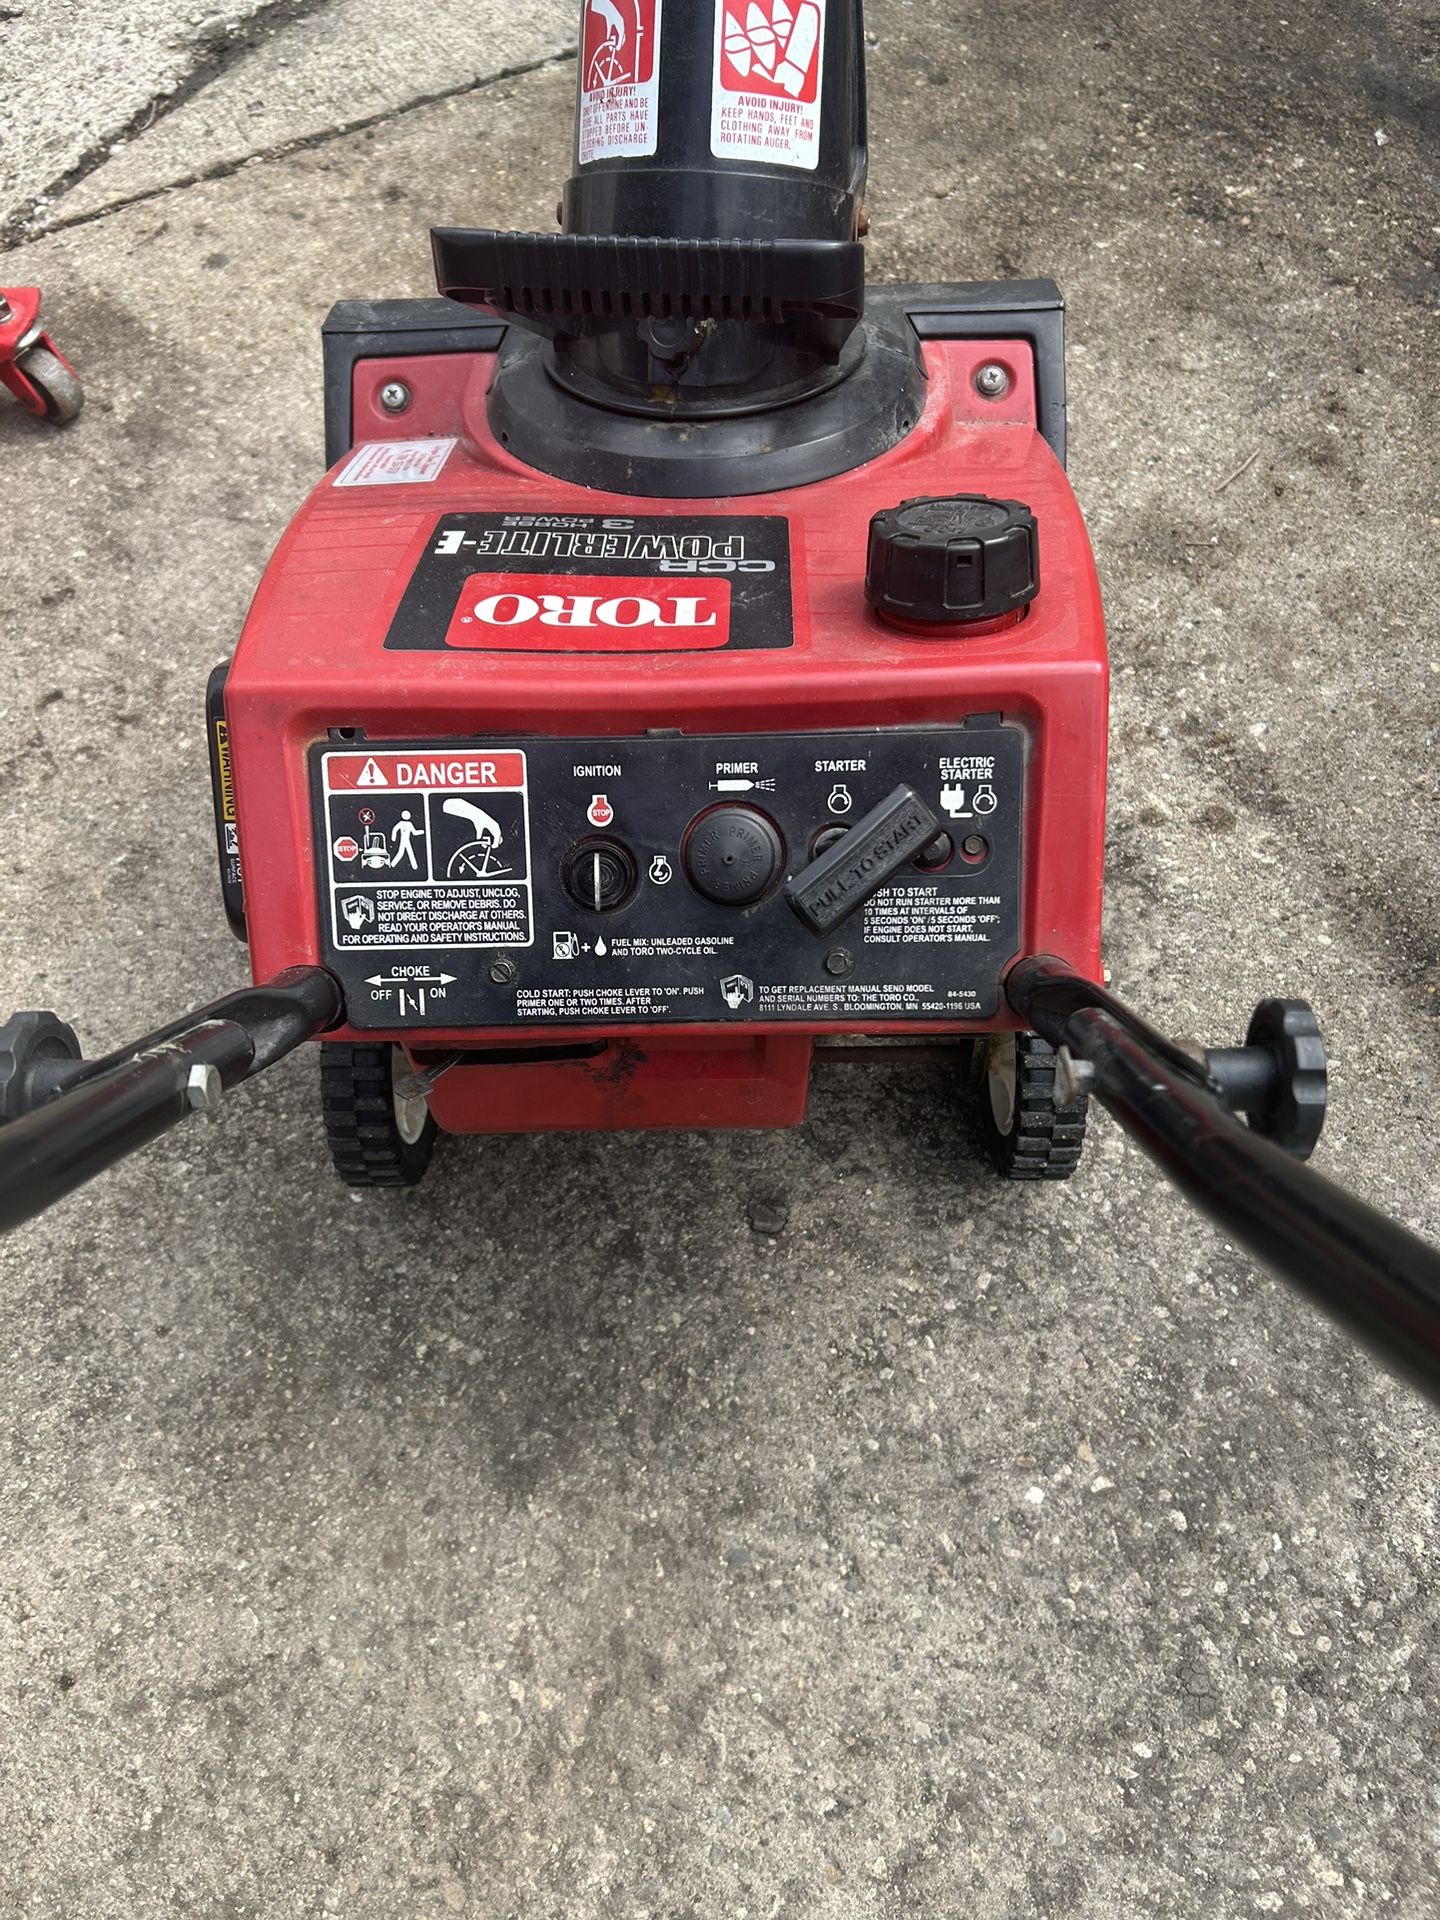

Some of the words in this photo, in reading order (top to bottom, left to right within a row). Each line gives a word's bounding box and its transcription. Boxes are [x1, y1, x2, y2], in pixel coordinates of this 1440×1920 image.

[589, 89, 605, 103] AVOID
[607, 86, 636, 99] INJURY!
[625, 98, 638, 109] AND
[640, 97, 649, 108] BE
[738, 95, 767, 109] AVOID
[770, 99, 804, 115] INJURY!
[594, 115, 603, 125] ALL
[606, 111, 627, 123] PARTS
[630, 110, 649, 121] HAVE
[721, 106, 744, 119] KEEP
[748, 109, 777, 124] HANDS,
[781, 114, 798, 126] FEET
[801, 118, 814, 130] AND
[605, 122, 630, 135] BEFORE
[720, 120, 763, 133] CLOTHING
[768, 125, 791, 137] AWAY
[795, 129, 813, 142] FROM
[608, 133, 648, 146] DISCHARGE
[720, 132, 762, 146] ROTATING
[764, 137, 791, 150] AUGER.
[504, 515, 594, 523] POWER
[602, 519, 635, 530] 3
[435, 530, 744, 560] POWERLITE-E
[659, 559, 777, 573] CCR
[716, 763, 759, 774] PRIMER
[815, 760, 866, 772] STARTER
[939, 757, 995, 769] ELECTRIC
[396, 762, 498, 786] DANGER
[573, 765, 622, 777] IGNITION
[940, 769, 993, 780] STARTER
[592, 809, 611, 817] STOP
[339, 845, 356, 853] STOP
[729, 826, 763, 862] PRIMER
[808, 876, 854, 918] PULL
[849, 856, 875, 879] TO
[873, 813, 924, 861] START
[376, 890, 399, 900] STOP
[401, 889, 432, 899] ENGINE
[434, 889, 446, 899] TO
[447, 888, 481, 899] ADJUST,
[482, 888, 521, 899] UNCLOG,
[892, 888, 905, 897] TO
[907, 887, 938, 897] START
[377, 901, 416, 911] SERVICE,
[417, 900, 430, 910] OR
[431, 900, 468, 910] REMOVE
[469, 899, 502, 909] DEBRIS.
[503, 899, 516, 909] DO
[896, 898, 913, 906] RUN
[915, 898, 951, 906] STARTER
[953, 897, 976, 905] MORE
[978, 896, 1001, 905] THAN
[378, 912, 396, 922] NOT
[397, 911, 428, 921] DIRECT
[429, 910, 478, 921] DISCHARGE
[479, 910, 490, 920] AT
[491, 910, 527, 920] OTHERS.
[864, 908, 873, 916] 10
[874, 908, 899, 916] TIMES
[900, 907, 910, 915] AT
[912, 907, 955, 915] INTERVALS
[957, 907, 968, 915] OF
[864, 917, 868, 925] 5
[870, 917, 909, 925] SECONDS
[937, 916, 976, 924] SECONDS
[379, 923, 403, 933] READ
[403, 922, 428, 933] YOUR
[429, 921, 482, 932] OPERATOR'S
[484, 921, 520, 931] MANUAL
[873, 926, 902, 934] ENGINE
[904, 926, 926, 934] DOES
[928, 925, 945, 933] NOT
[343, 935, 361, 945] FOR
[362, 934, 410, 945] OPERATING
[411, 933, 429, 944] AND
[430, 932, 463, 943] SAFETY
[464, 932, 527, 942] INSTRUCTIONS.
[612, 938, 630, 947] FUEL
[632, 938, 650, 947] MIX:
[651, 937, 694, 946] UNLEADED
[695, 937, 735, 946] GASOLINE
[864, 935, 901, 943] CONSULT
[902, 934, 953, 943] OPERATOR'S
[954, 934, 991, 942] MANUAL.
[612, 948, 629, 957] AND
[630, 947, 655, 956] TORO
[656, 946, 702, 956] TWO-CYCLE
[703, 946, 719, 955] OIL.
[391, 966, 430, 978] CHOKE
[371, 990, 392, 1001] OFF
[430, 988, 447, 999] ON
[517, 990, 541, 998] COLD
[542, 989, 572, 998] START:
[573, 989, 595, 998] PUSH
[596, 988, 623, 997] CHOKE
[625, 988, 650, 997] LEVER
[652, 988, 663, 996] TO
[683, 987, 705, 995] PUSH
[759, 986, 770, 994] TO
[771, 986, 788, 994] GET
[848, 985, 882, 993] MANUAL
[883, 985, 905, 993] SEND
[906, 985, 935, 993] MODEL
[517, 999, 547, 1007] PRIMER
[548, 998, 565, 1007] ONE
[567, 998, 579, 1007] OR
[579, 998, 598, 1006] TWO
[626, 997, 652, 1006] AFTER
[759, 995, 776, 1003] AND
[777, 995, 806, 1003] SERIAL
[847, 994, 860, 1002] TO:
[862, 994, 878, 1002] THE
[879, 994, 902, 1002] TORO
[517, 1008, 558, 1017] STARTING,
[559, 1007, 580, 1016] PUSH
[582, 1007, 610, 1015] CHOKE
[611, 1006, 637, 1015] LEVER
[638, 1006, 649, 1014] TO
[759, 1004, 775, 1012] 8111
[777, 1004, 812, 1012] LYNDALE
[844, 1003, 904, 1012] BLOOMINGTON,
[906, 1003, 918, 1011] MN
[965, 1002, 981, 1010] USA
